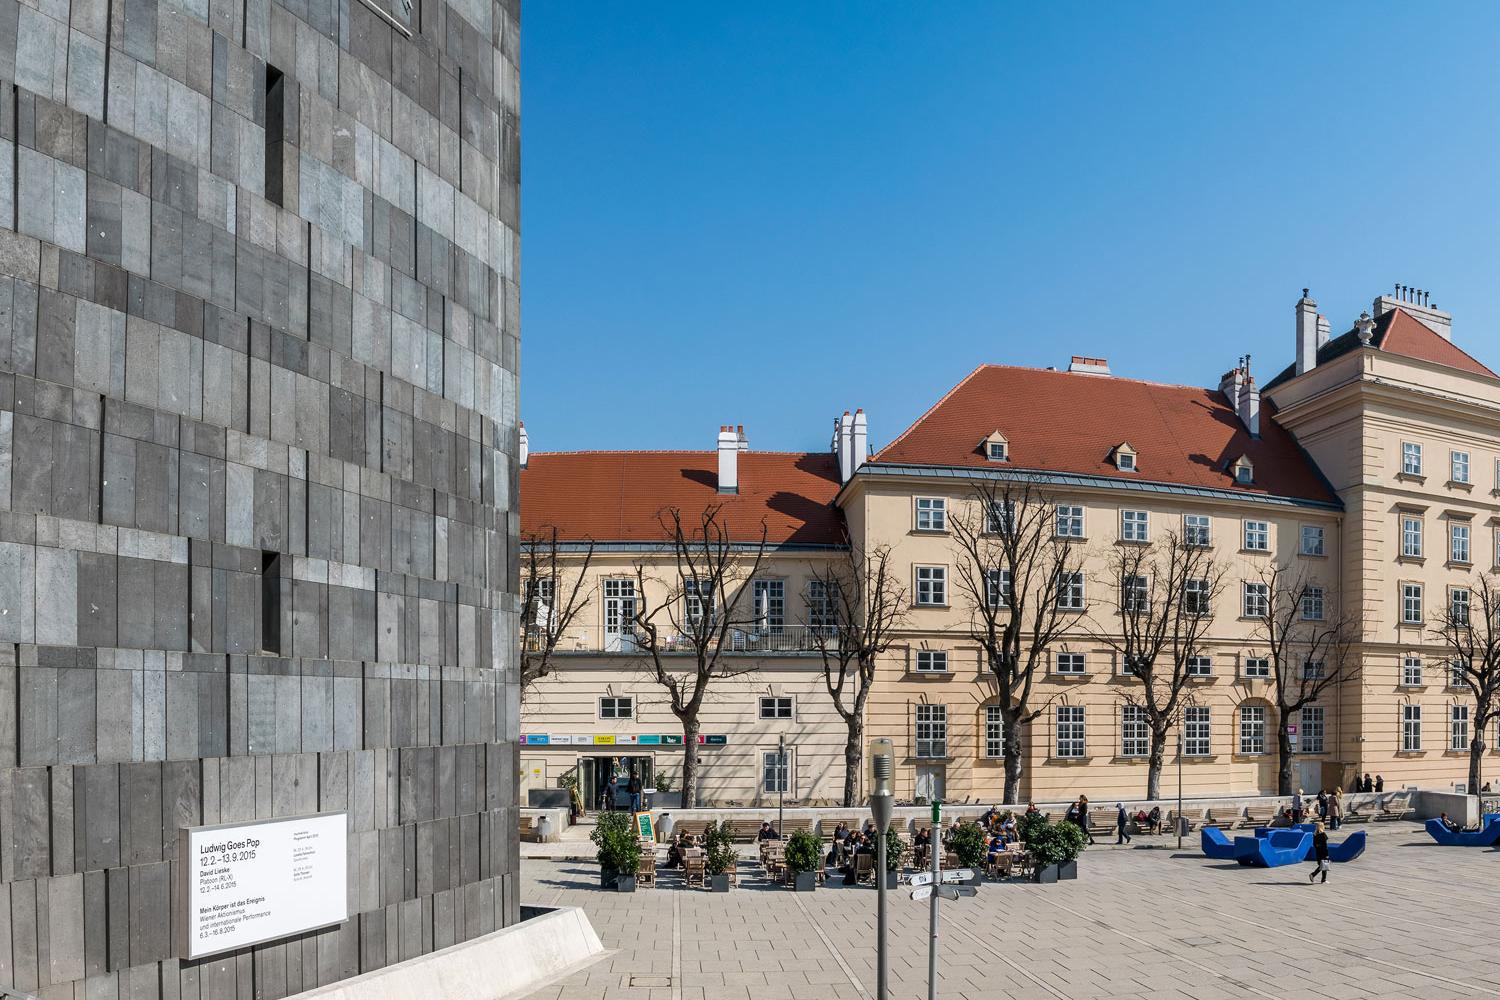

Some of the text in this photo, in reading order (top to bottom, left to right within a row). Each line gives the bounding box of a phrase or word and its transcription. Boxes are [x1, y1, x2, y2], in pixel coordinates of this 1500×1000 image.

[200, 838, 260, 854] Ludwig Goes Pop
[200, 866, 230, 877] David Lieske
[200, 877, 218, 885] Platoon
[200, 905, 212, 914] Mein
[212, 903, 229, 911] Körper
[246, 896, 266, 905] Ereignis
[200, 909, 246, 922] Wiener Aktionismus
[210, 917, 242, 928] internationale
[242, 911, 271, 921] Performance
